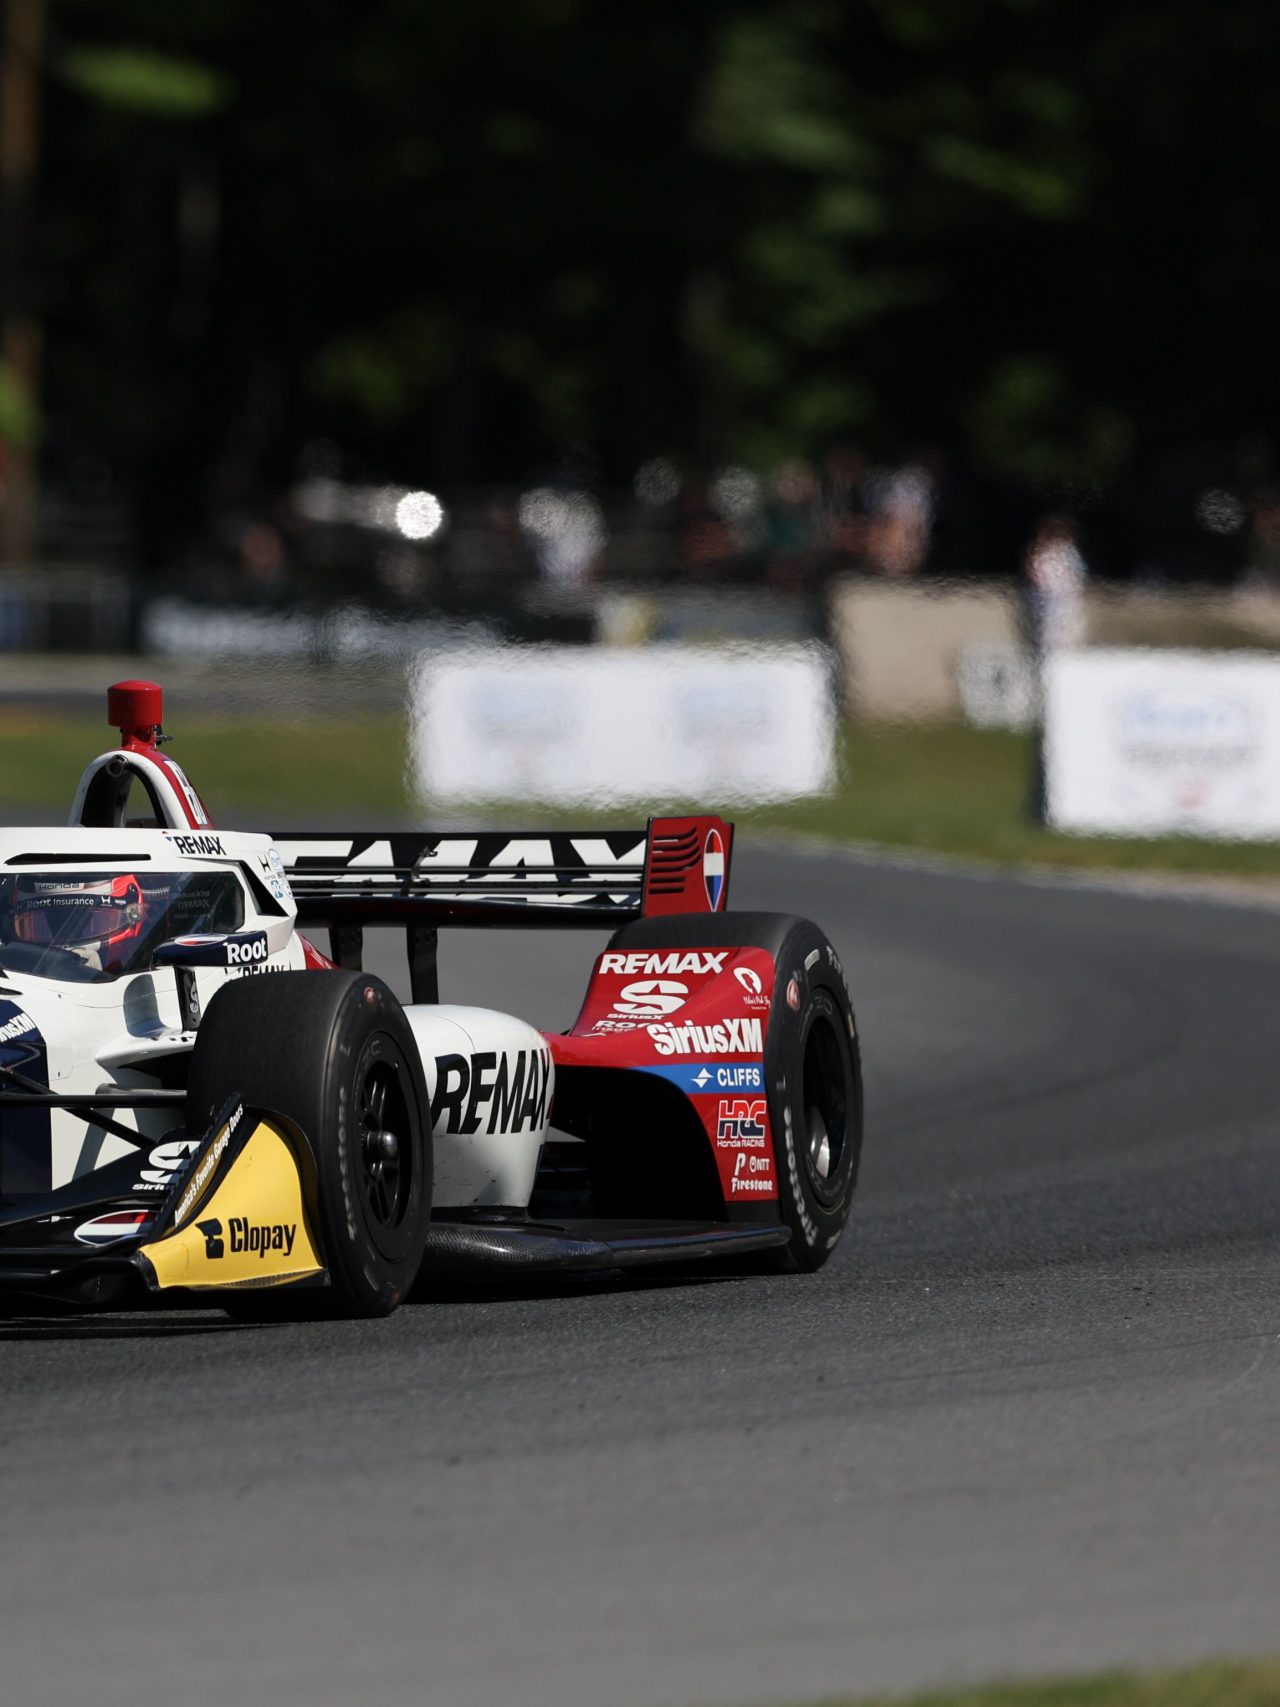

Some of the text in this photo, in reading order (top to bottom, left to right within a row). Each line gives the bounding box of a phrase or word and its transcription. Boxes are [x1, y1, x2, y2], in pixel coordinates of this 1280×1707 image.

[173, 836, 227, 856] REMAX
[53, 896, 95, 906] Insurance
[227, 937, 267, 964] Root
[599, 952, 729, 974] REMAX
[595, 1020, 652, 1029] Ro
[647, 1018, 763, 1056] SiriusXM
[717, 1068, 761, 1086] CLIFFS
[431, 1048, 551, 1135] REMAX
[717, 1100, 767, 1139] HRC
[195, 1154, 215, 1190] Favorite
[213, 1126, 231, 1160] Garage
[731, 1176, 773, 1193] Firestone
[228, 1216, 297, 1259] Clopay
